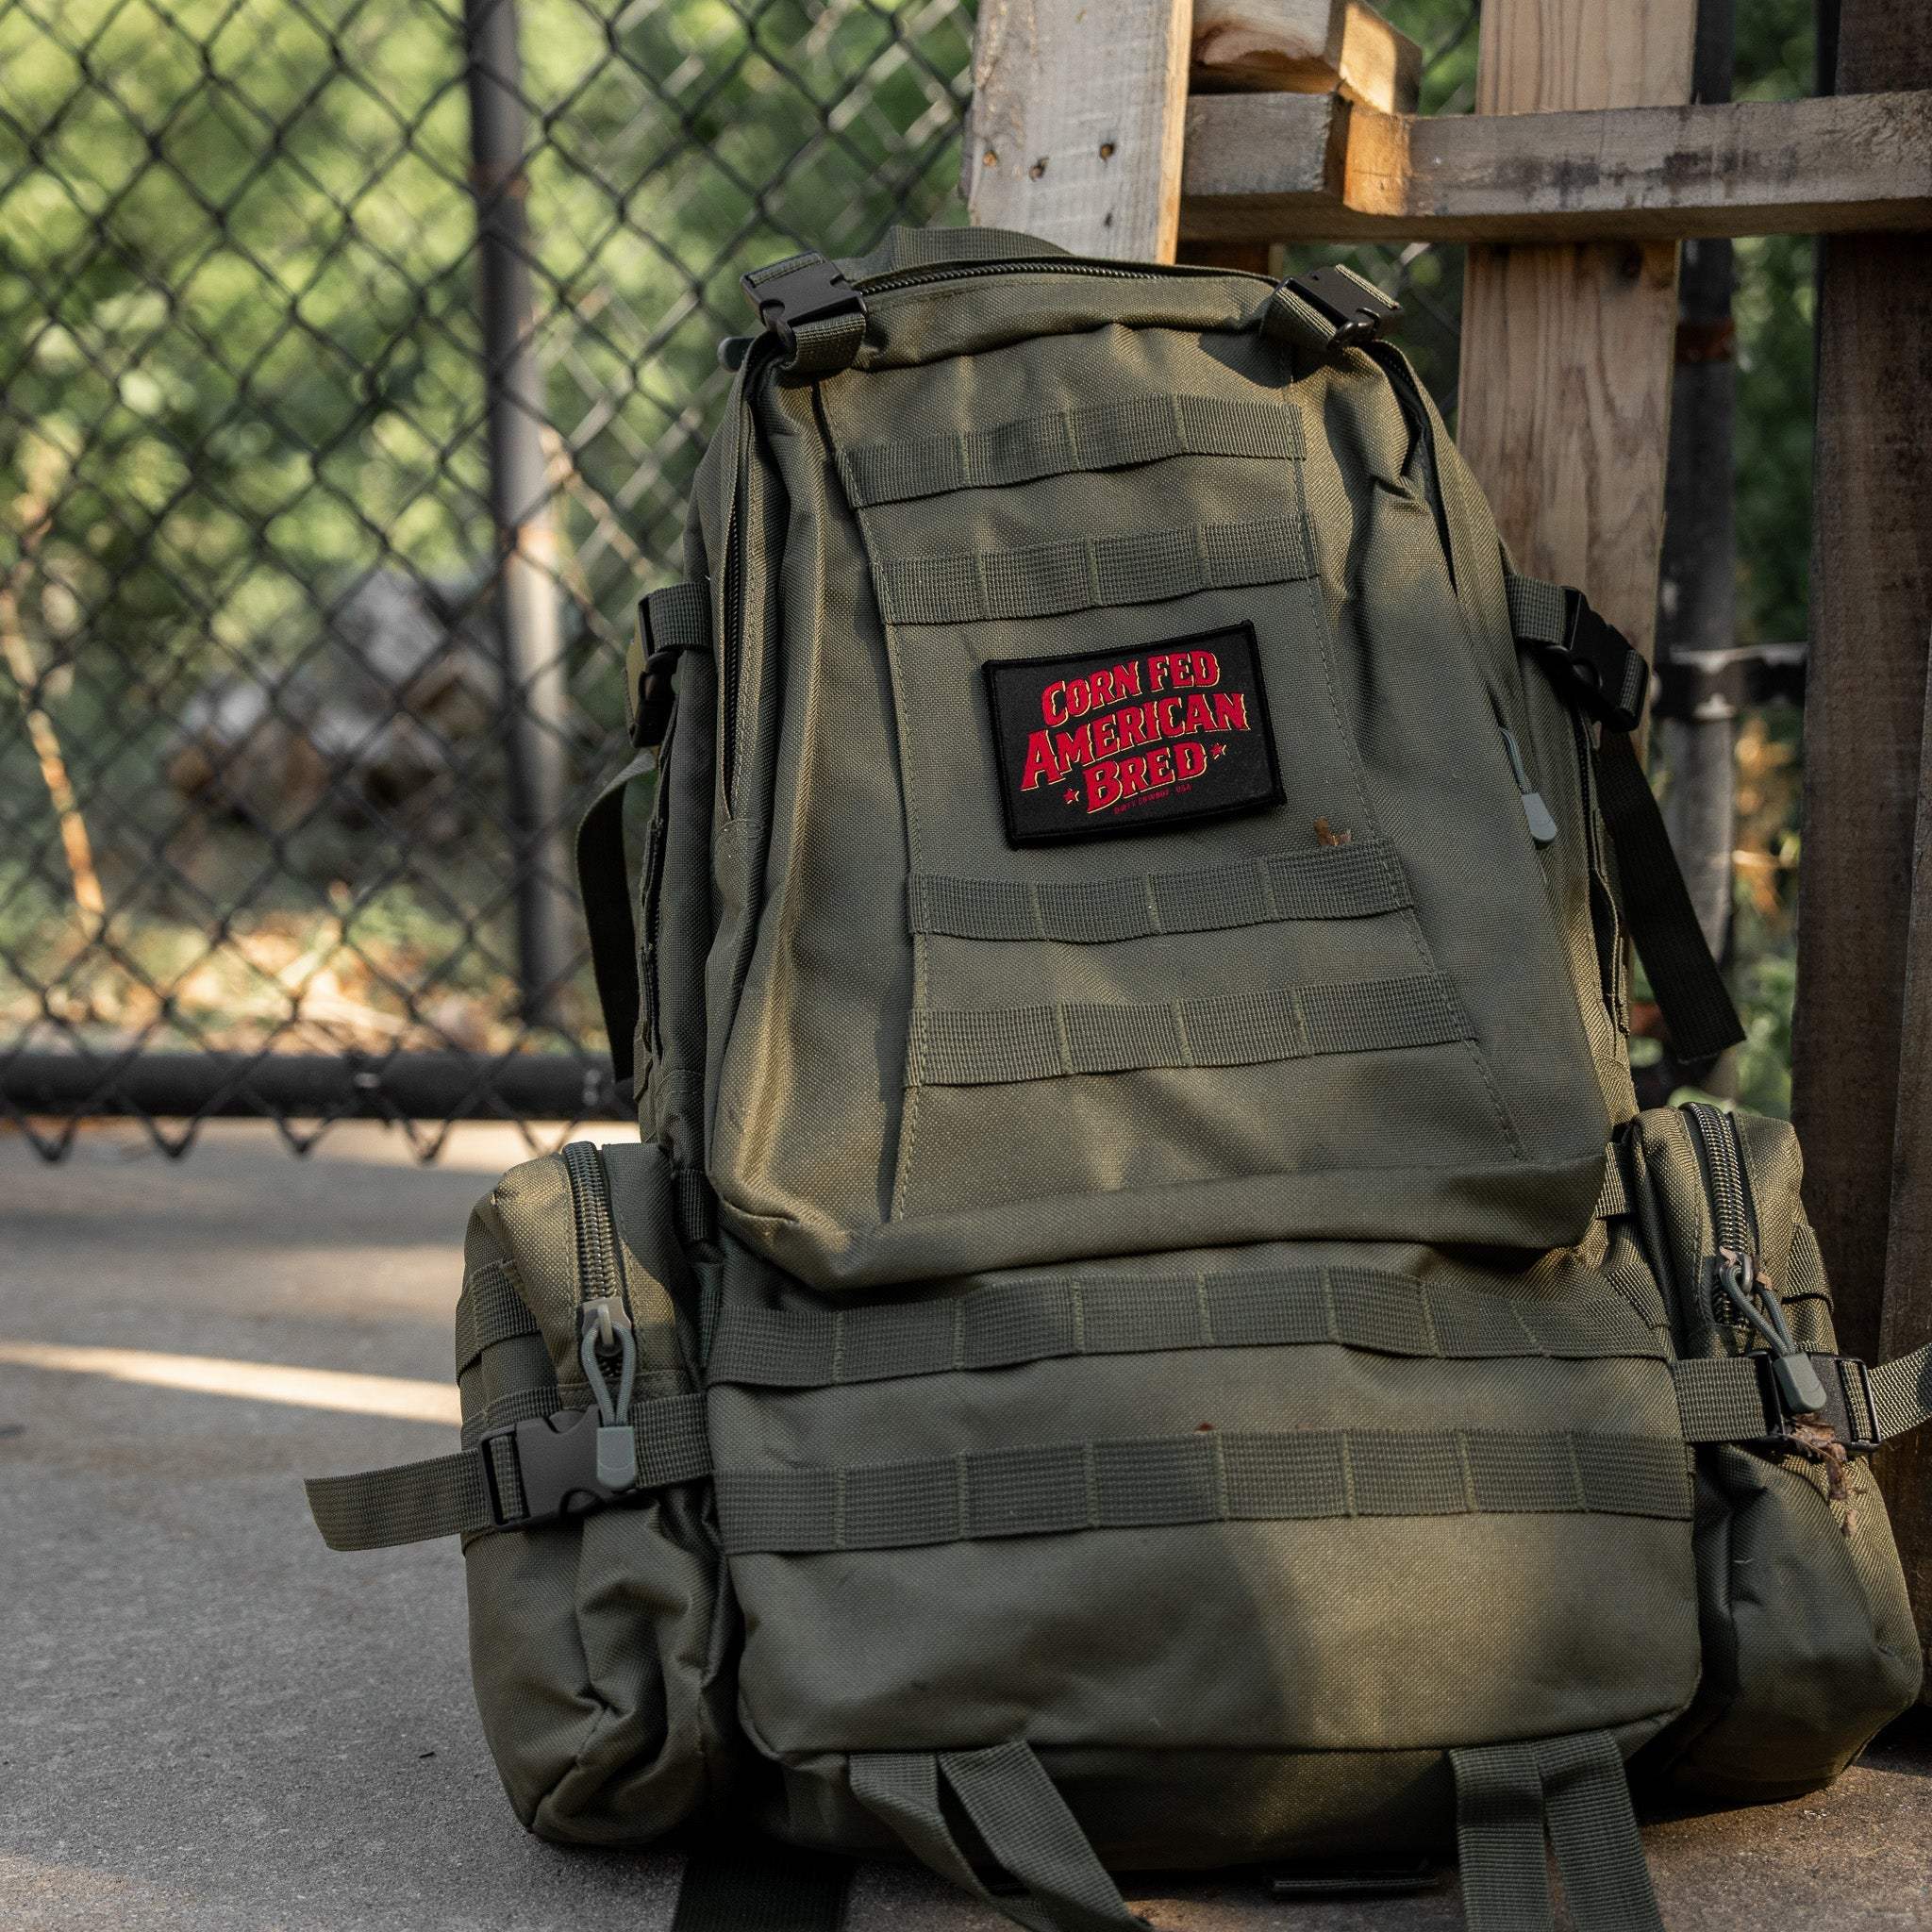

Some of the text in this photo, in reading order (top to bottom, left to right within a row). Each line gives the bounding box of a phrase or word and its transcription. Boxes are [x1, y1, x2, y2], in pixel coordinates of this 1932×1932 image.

[1041, 649, 1222, 727] CORN FED
[1019, 692, 1252, 791] AMERICAN
[1082, 741, 1208, 814] BRED
